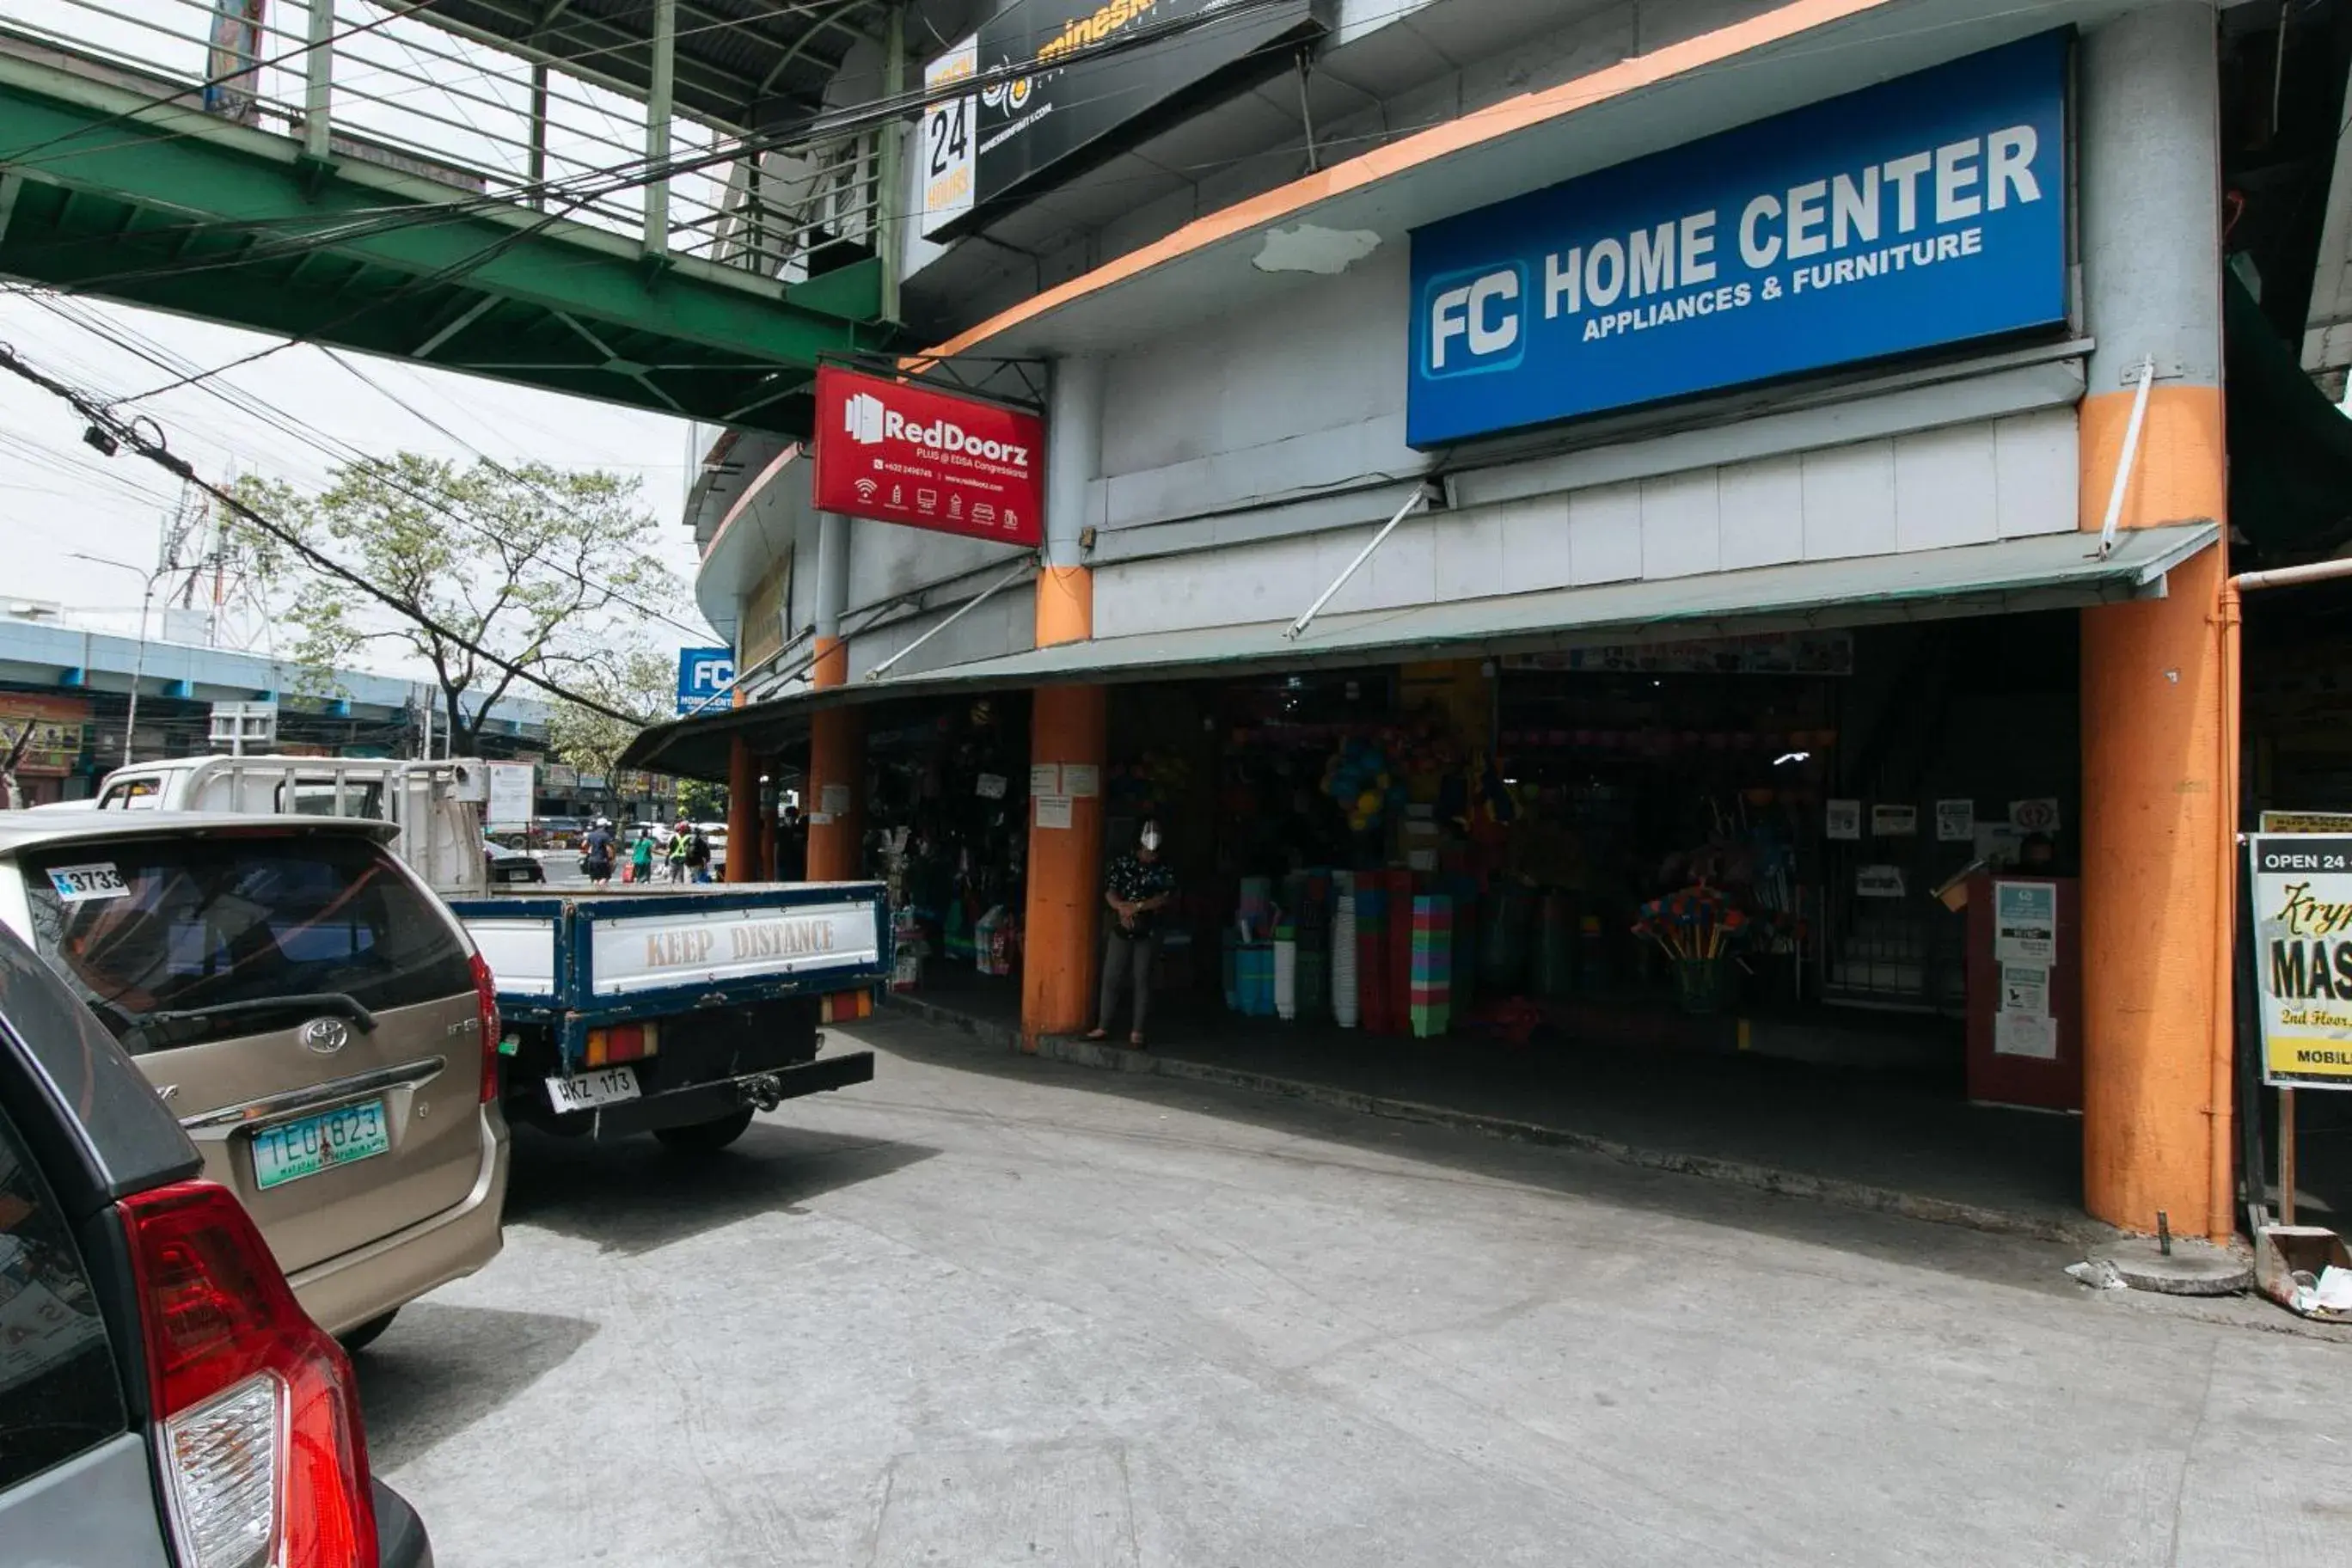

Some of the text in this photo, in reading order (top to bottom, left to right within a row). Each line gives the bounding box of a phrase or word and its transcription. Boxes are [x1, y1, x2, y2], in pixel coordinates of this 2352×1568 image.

[930, 93, 968, 178] 24
[1545, 125, 2043, 320] HOME CENTER
[1582, 227, 1983, 342] APPLIANCES & FURNITURE
[1432, 269, 1518, 370] FC
[885, 409, 1028, 467] RedDoorz
[916, 447, 940, 461] PLUS
[951, 456, 973, 468] EDSA
[695, 659, 733, 690] FC
[69, 869, 124, 892] 3733
[2264, 854, 2345, 869] OPEN 24
[646, 920, 834, 967] KEEP DISTANCE
[2271, 940, 2352, 1001] MAS
[2281, 1009, 2306, 1025] 2nd
[600, 1070, 630, 1093] 173
[330, 1109, 377, 1147] 823
